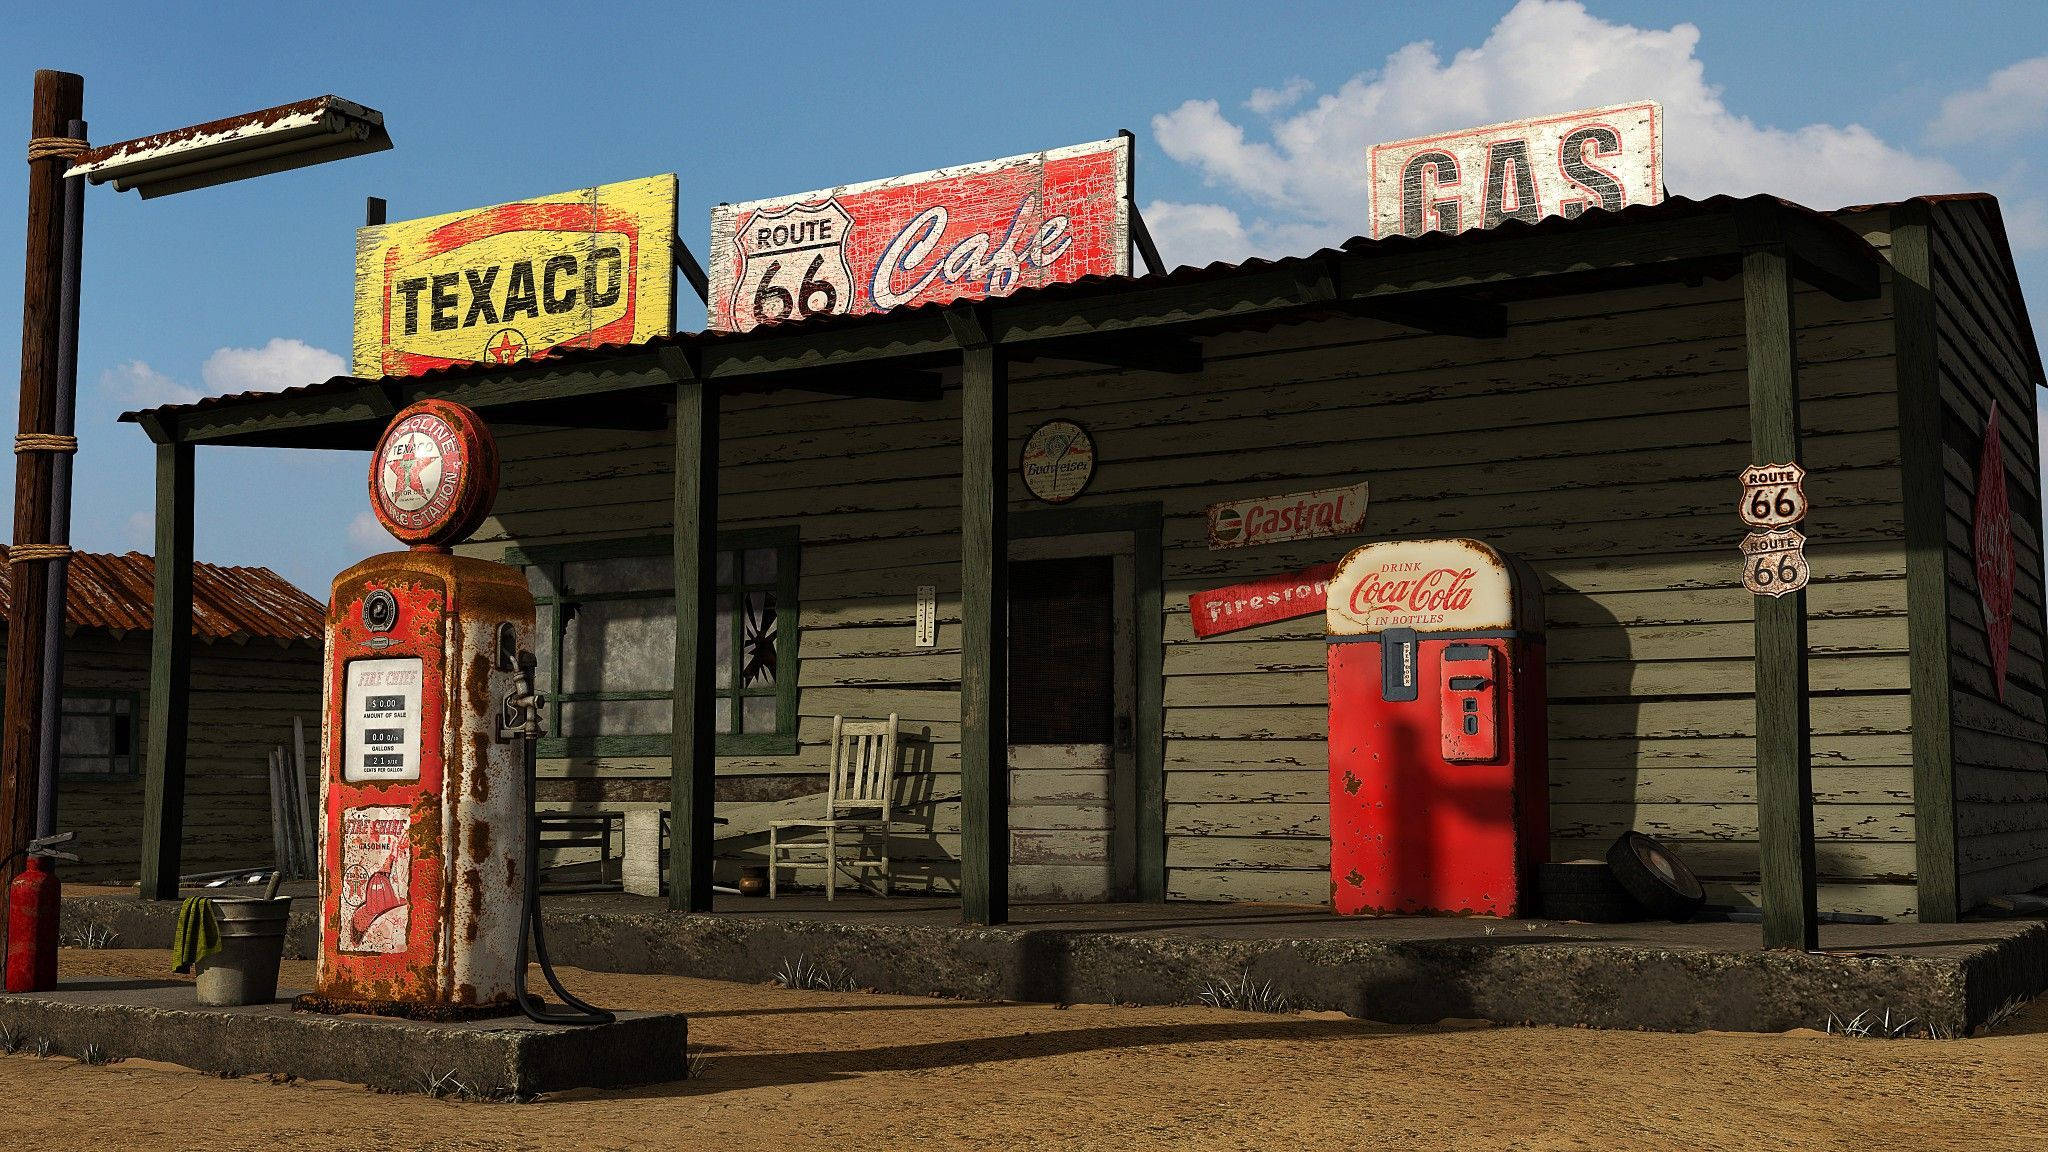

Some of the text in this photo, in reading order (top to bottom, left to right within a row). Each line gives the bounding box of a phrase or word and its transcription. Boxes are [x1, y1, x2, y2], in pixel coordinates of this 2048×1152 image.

[1400, 122, 1627, 237] GAS
[757, 217, 833, 249] ROUTE
[870, 193, 1074, 312] Cafe
[396, 246, 621, 336] TEXACO
[753, 253, 837, 323] 66
[393, 441, 434, 456] TEXACO
[1028, 461, 1088, 476] Budweiser
[1749, 471, 1795, 485] ROUTE
[411, 471, 458, 526] STATION
[1751, 488, 1795, 519] 66
[1245, 495, 1345, 538] Castrol
[1750, 538, 1796, 552] ROUTE
[1381, 562, 1422, 573] DRINK
[1754, 554, 1797, 586] 66
[1206, 580, 1329, 623] Fireston
[1349, 567, 1480, 615] Coca-Cola
[1375, 614, 1444, 626] IN BOTTLES
[379, 699, 397, 708] 0.00
[359, 842, 391, 851] GASOLINE
